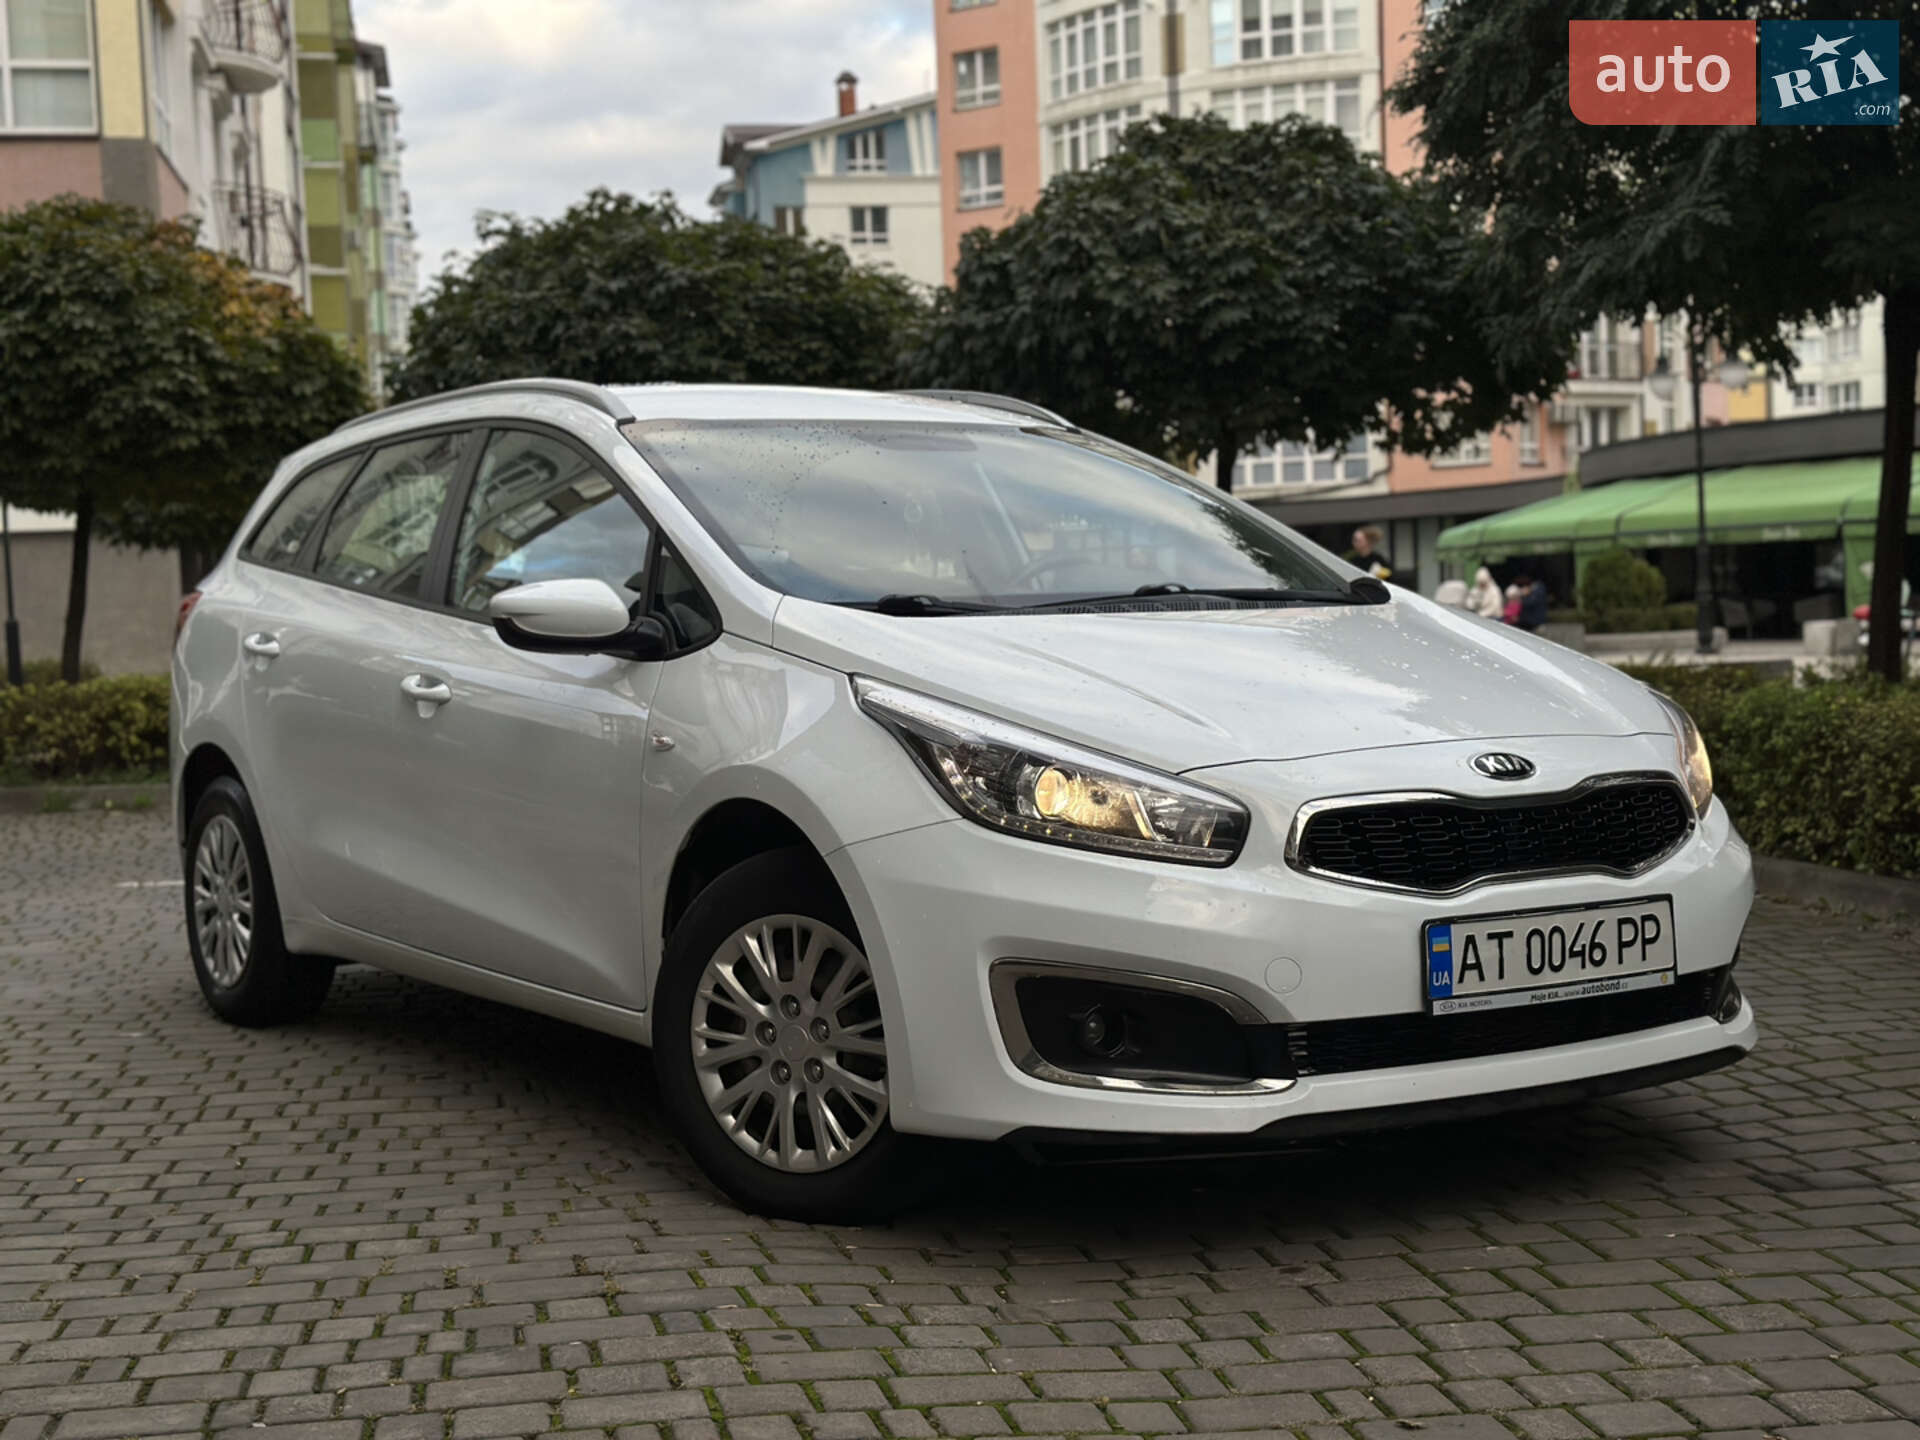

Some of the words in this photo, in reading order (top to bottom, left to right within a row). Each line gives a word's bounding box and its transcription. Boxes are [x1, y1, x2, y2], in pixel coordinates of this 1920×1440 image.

[1479, 755, 1531, 773] KIA
[1457, 930, 1514, 984] AT
[1526, 919, 1607, 976] 0046
[1617, 913, 1661, 965] PP
[1432, 970, 1451, 986] UA
